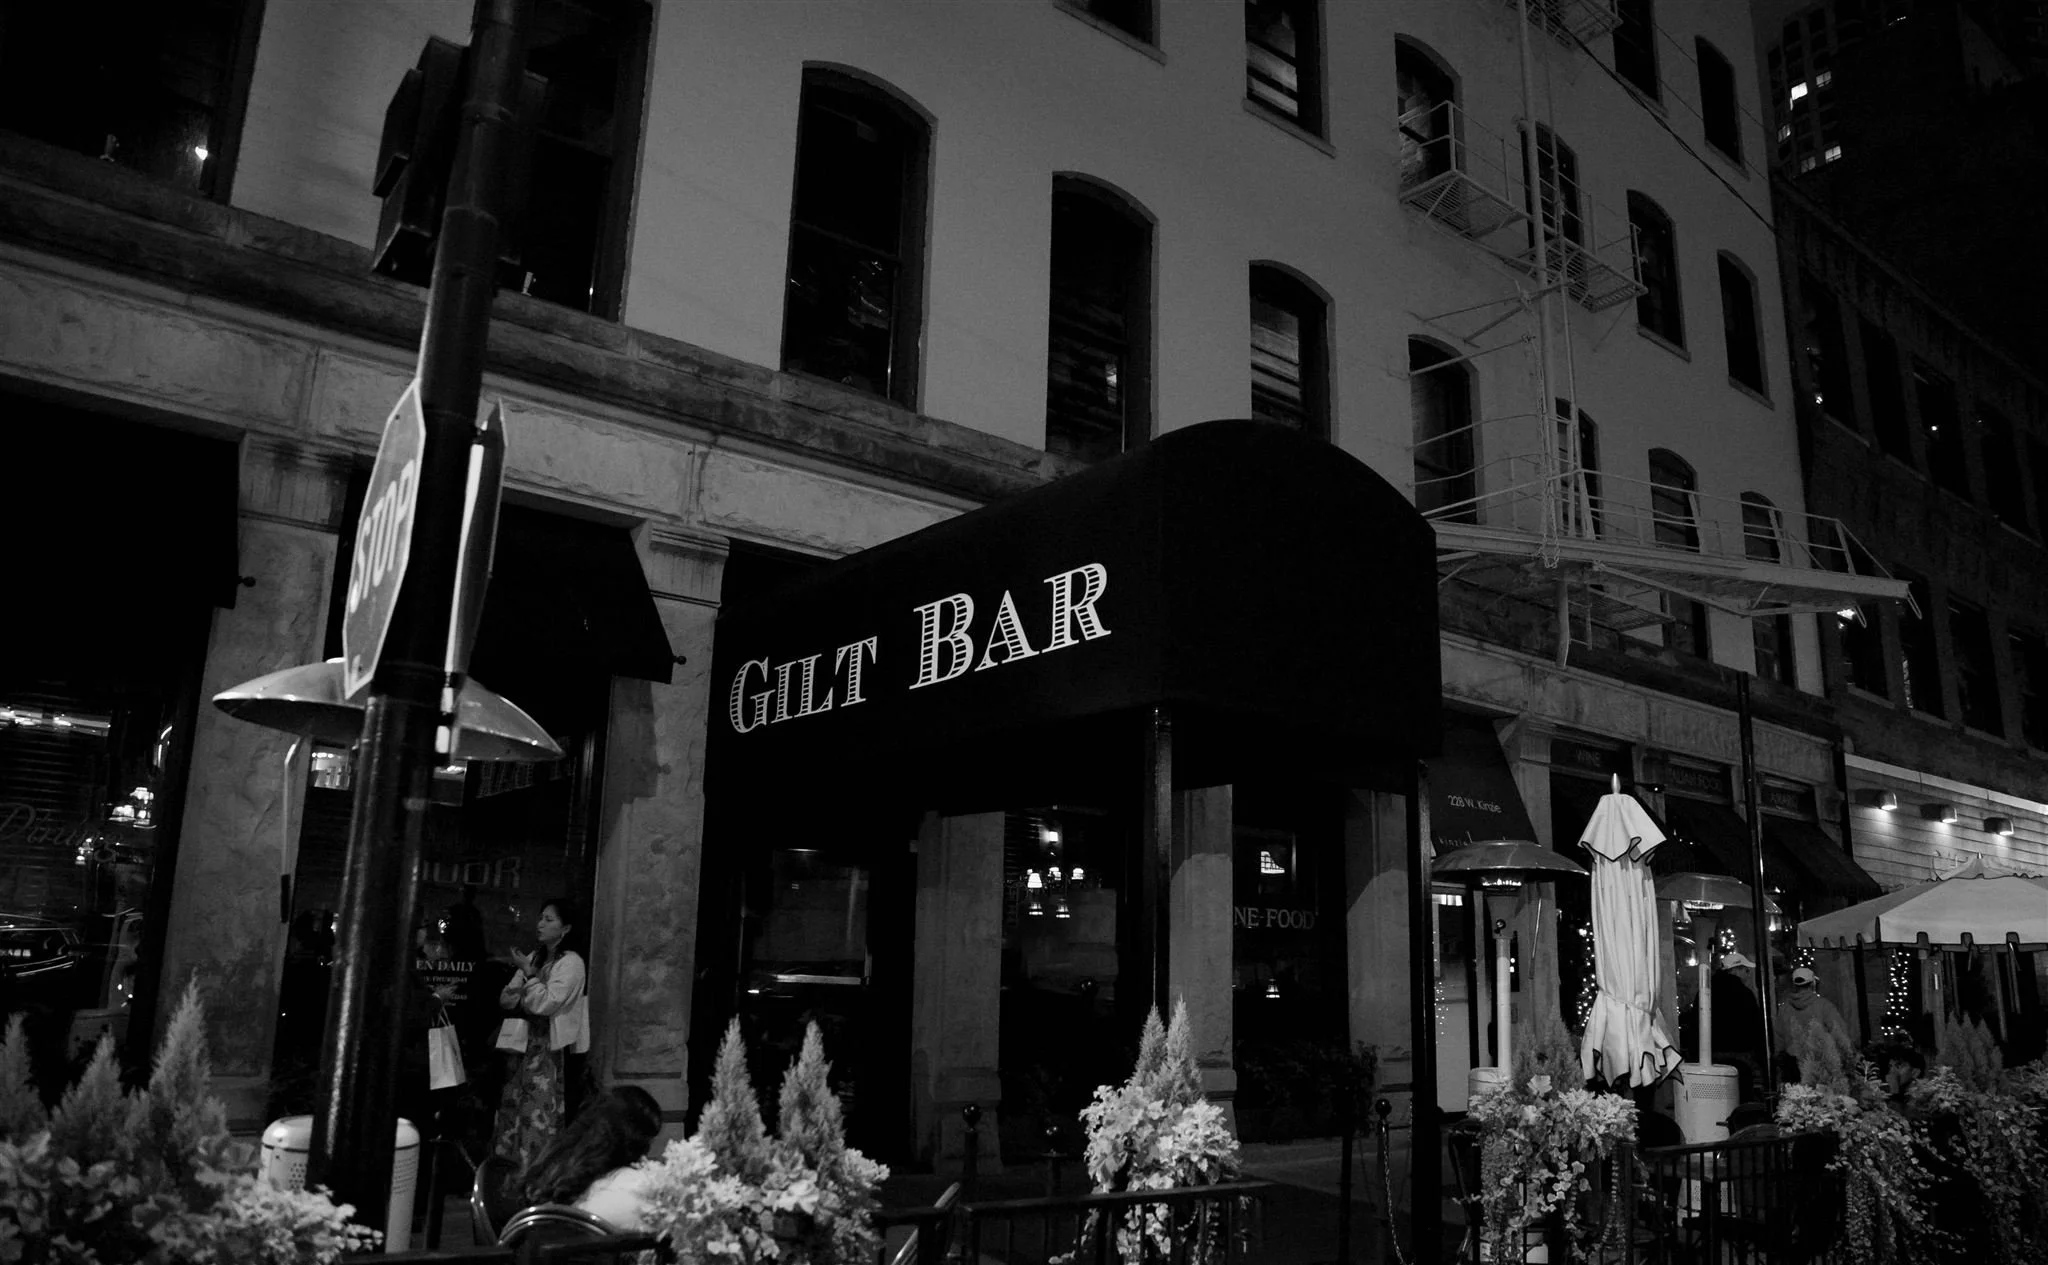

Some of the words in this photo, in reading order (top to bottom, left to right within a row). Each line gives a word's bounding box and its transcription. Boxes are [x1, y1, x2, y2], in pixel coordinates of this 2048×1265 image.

[348, 457, 415, 615] STOP
[728, 635, 880, 734] GILT
[908, 562, 1113, 690] BAR
[1447, 794, 1466, 808] 228
[422, 855, 521, 889] UOR
[437, 959, 476, 973] DAILY
